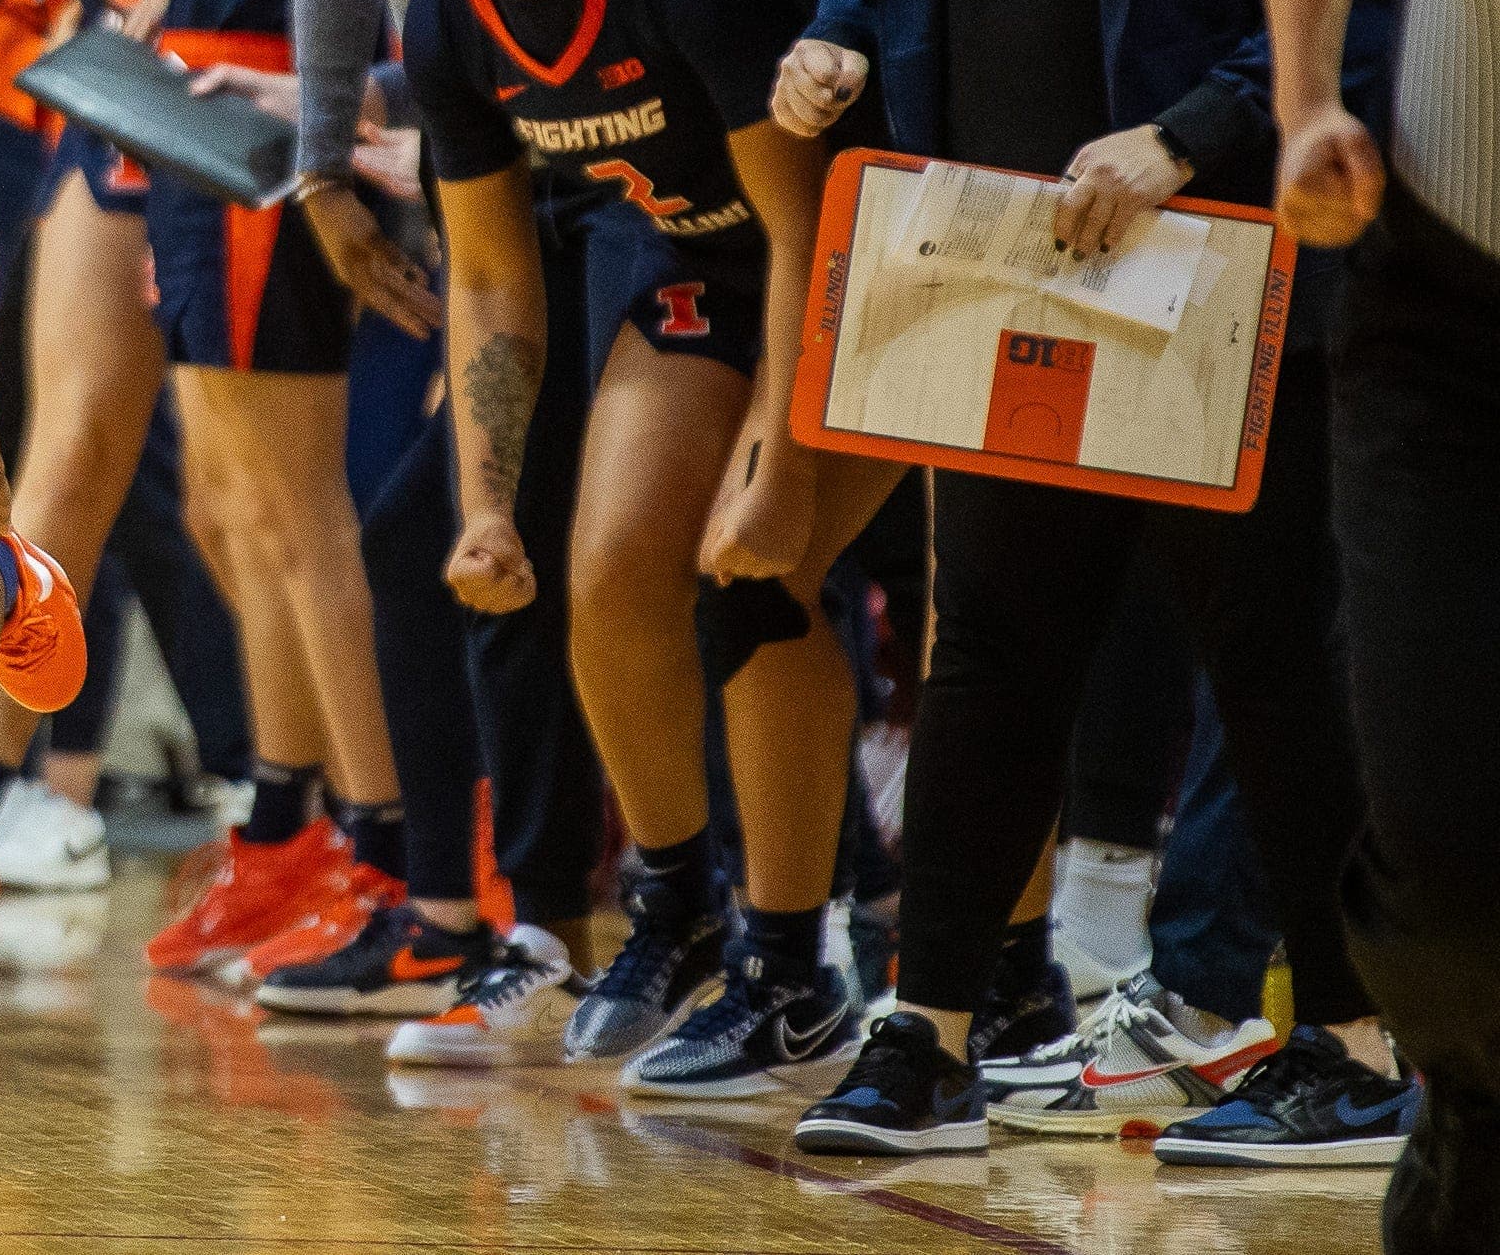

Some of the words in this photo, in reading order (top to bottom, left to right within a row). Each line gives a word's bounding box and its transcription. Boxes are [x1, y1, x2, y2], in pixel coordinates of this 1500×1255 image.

[514, 98, 667, 154] FIGHTING
[657, 281, 710, 337] I
[819, 248, 847, 333] ILLINOIS
[1243, 342, 1278, 452] FIGHTING
[1263, 267, 1290, 337] ILLINI
